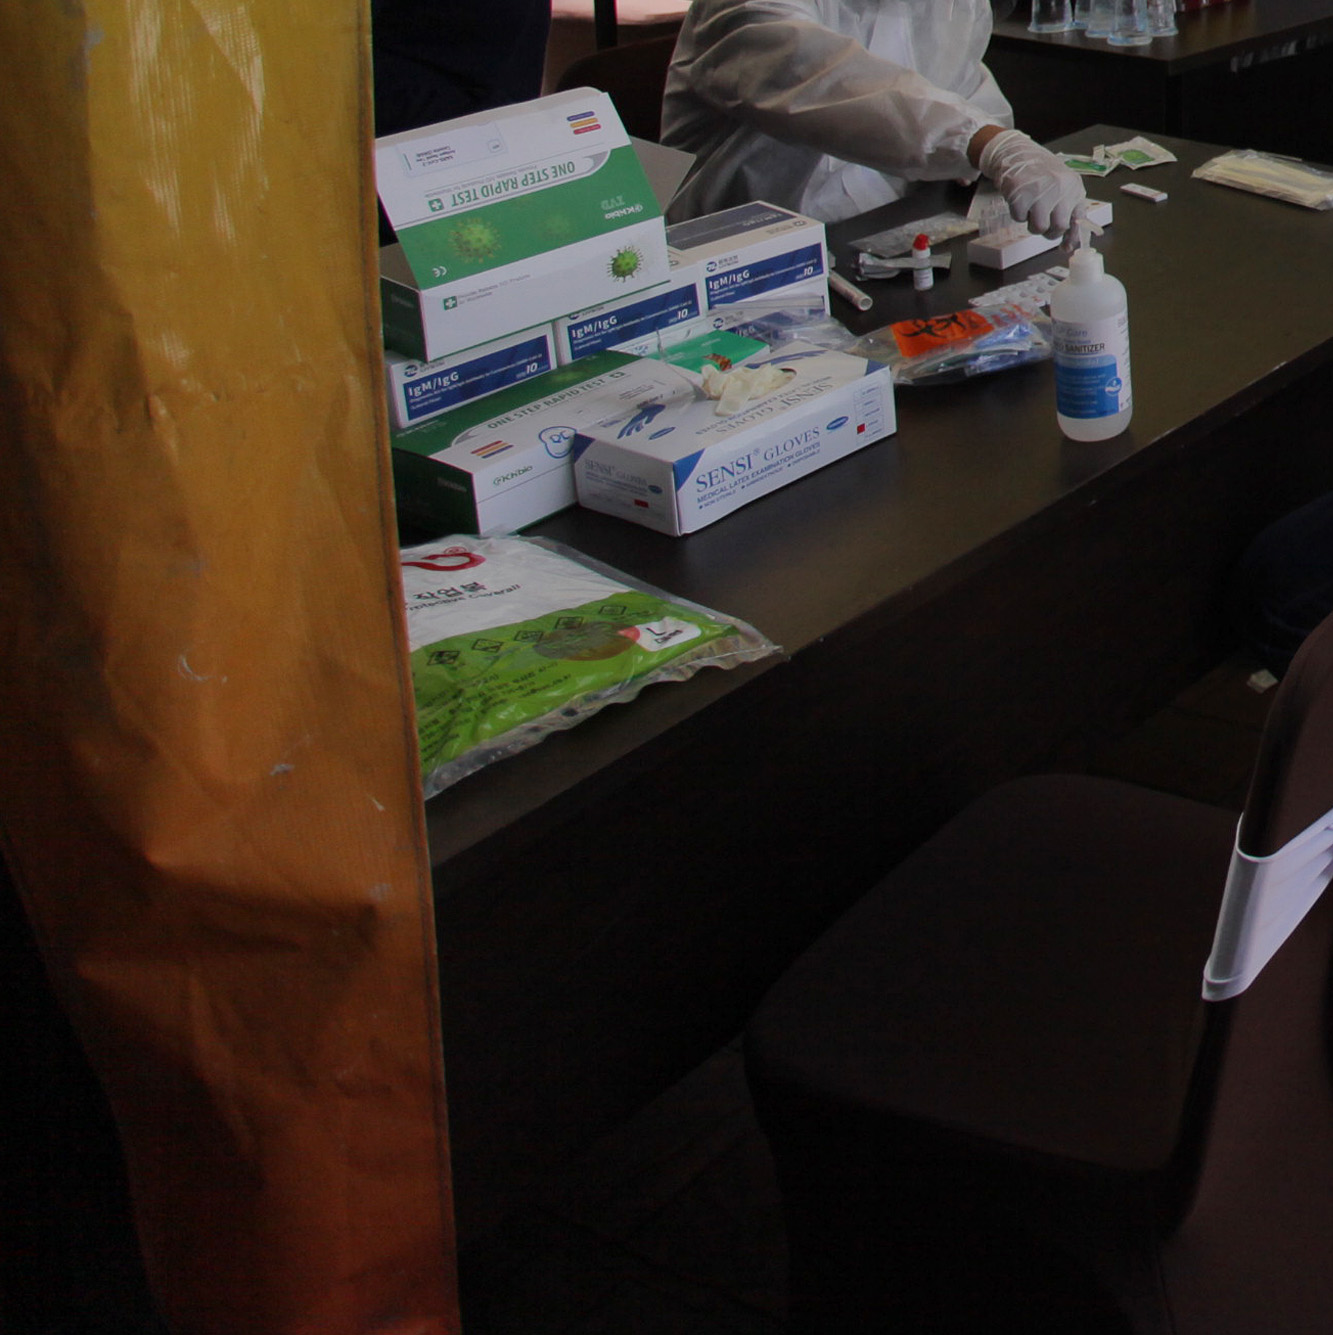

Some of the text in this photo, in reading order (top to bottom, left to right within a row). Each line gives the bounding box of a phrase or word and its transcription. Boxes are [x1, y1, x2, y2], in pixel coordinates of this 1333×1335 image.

[521, 167, 550, 188] STEP
[551, 160, 576, 179] ONE
[450, 186, 479, 207] TEST
[481, 175, 519, 200] RAPID
[708, 269, 750, 290] IgM/IgG
[676, 308, 689, 320] 10
[571, 315, 618, 339] IgM/IgG
[525, 361, 539, 375] 10
[407, 371, 460, 399] IgM/IgG
[487, 415, 512, 430] ONE
[514, 403, 542, 424] STEP
[763, 426, 821, 462] GLOVES
